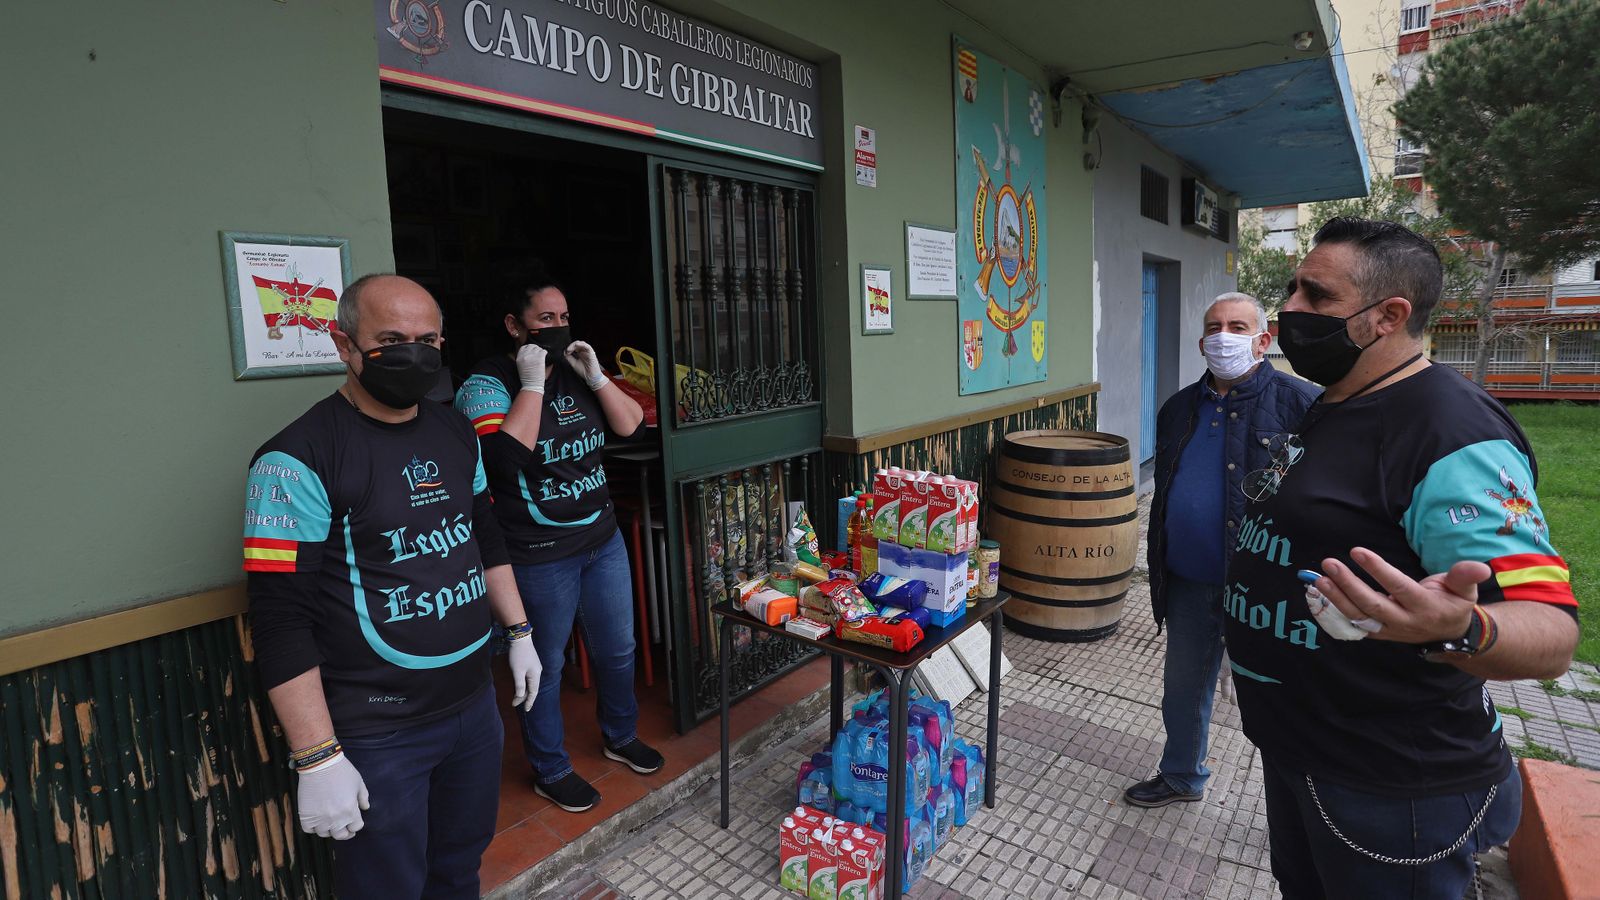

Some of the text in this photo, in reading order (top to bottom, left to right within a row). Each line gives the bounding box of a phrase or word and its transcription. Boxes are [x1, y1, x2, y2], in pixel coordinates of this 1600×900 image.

[556, 0, 813, 89] GUOS CABALLEROS LEGIONARIOS
[464, 0, 815, 138] CAMPO DE GIBRALTAR
[537, 428, 605, 464] Legión
[1012, 468, 1066, 484] CONSEJO
[1073, 475, 1090, 484] DE
[1096, 475, 1110, 484] LA
[269, 483, 293, 504] La
[874, 489, 895, 499] Entera
[901, 494, 923, 504] Entera
[929, 499, 951, 508] Entera
[246, 509, 299, 529] Muerte
[1445, 504, 1480, 526] 19
[380, 513, 473, 564] Legió
[1034, 544, 1114, 559] ALTA RÍO
[781, 839, 802, 853] Entera
[809, 850, 832, 863] Entera
[838, 864, 861, 876] Entera
